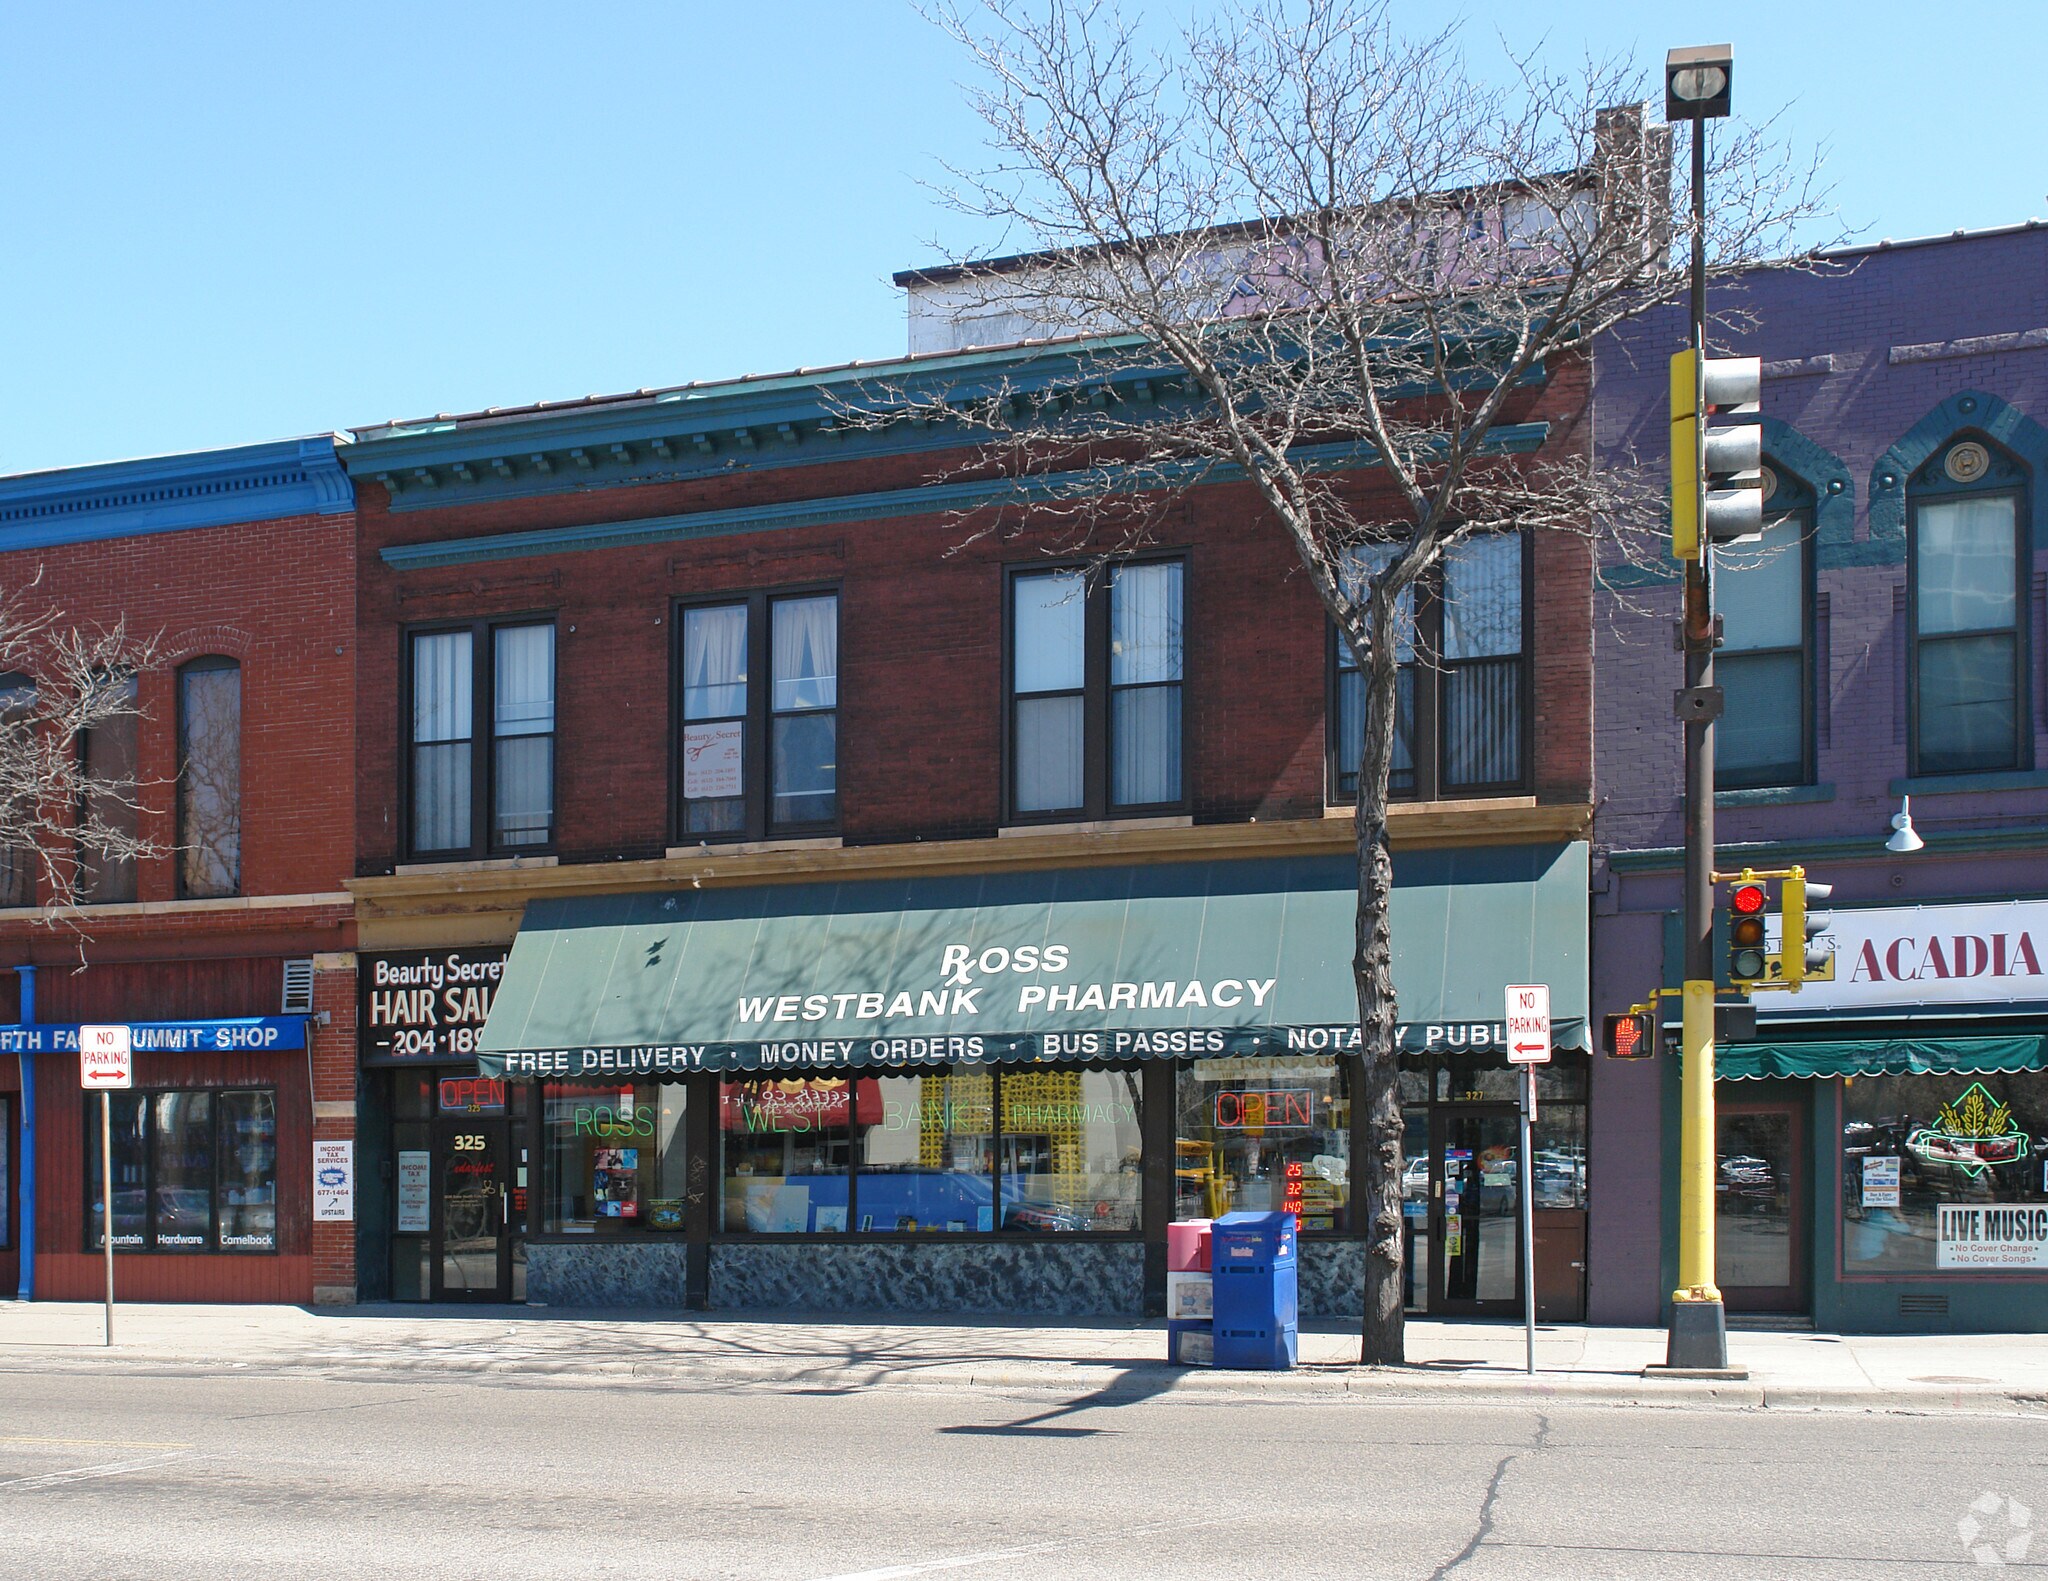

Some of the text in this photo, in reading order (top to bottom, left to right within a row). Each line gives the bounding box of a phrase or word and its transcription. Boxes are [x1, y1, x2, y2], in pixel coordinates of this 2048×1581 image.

[684, 730, 741, 742] Beauty Secret
[1849, 932, 2046, 983] ACADIA
[375, 957, 444, 989] Beauty
[370, 986, 492, 1026] HAIR SAL
[738, 978, 1277, 1024] WESTBANK PHARMACY
[1519, 991, 1535, 1009] NO
[1287, 1023, 1507, 1049] NOTAY PUBL
[1509, 1016, 1547, 1033] PARKING
[53, 1030, 80, 1049] FA
[130, 1028, 202, 1048] UMMIT
[216, 1027, 278, 1048] SHOP
[96, 1031, 114, 1045] NO
[1043, 1030, 1224, 1055] BUS PASSES
[84, 1050, 128, 1065] PARKING
[505, 1046, 706, 1072] FREE DELIVERY
[760, 1036, 985, 1064] MONEY ORDERS
[441, 1078, 505, 1107] OPEN
[1465, 1091, 1484, 1100] 327
[467, 1104, 481, 1113] 325
[742, 1102, 823, 1133] WEST
[884, 1100, 970, 1132] BANK
[1013, 1102, 1136, 1125] PHARMACY
[1217, 1092, 1311, 1126] OPEN
[574, 1105, 654, 1138] ROSS
[453, 1134, 487, 1151] 325
[1282, 1200, 1302, 1214] 140
[1941, 1208, 2048, 1242] LIVE MUSIC
[157, 1234, 203, 1244] Hardware
[220, 1234, 273, 1245] Camelback
[1955, 1243, 2033, 1253] No Cover Charge
[1957, 1254, 2032, 1264] No Cover Songs
